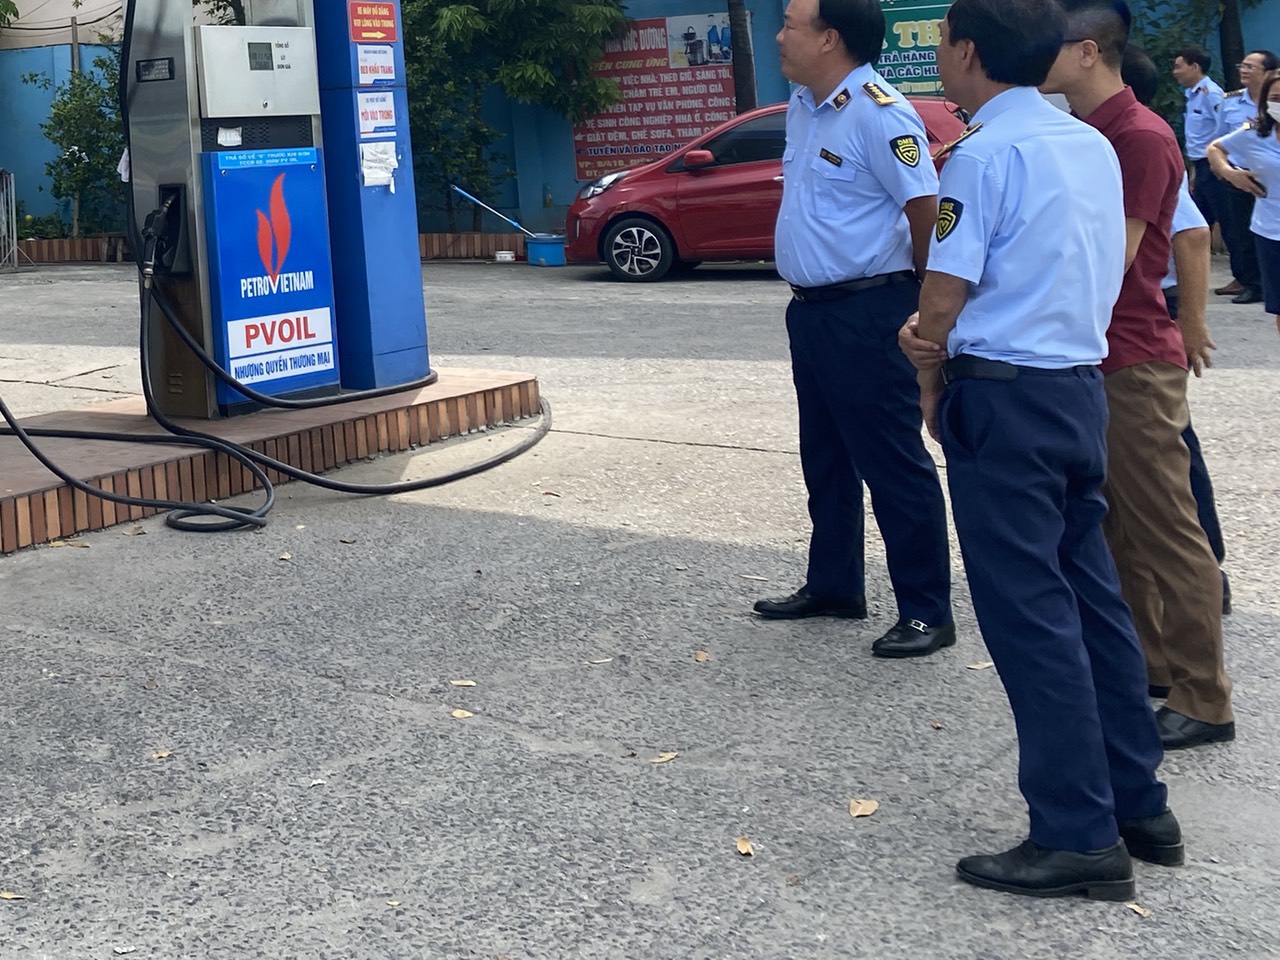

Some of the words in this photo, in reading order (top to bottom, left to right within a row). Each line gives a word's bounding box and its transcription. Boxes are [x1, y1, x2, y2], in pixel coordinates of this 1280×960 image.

[902, 51, 935, 62] HÀNG
[897, 65, 920, 76] CÁC
[660, 73, 678, 83] THEO
[241, 271, 313, 298] PETROVIETNAM
[245, 316, 315, 348] PVOIL
[317, 351, 330, 367] MẠI
